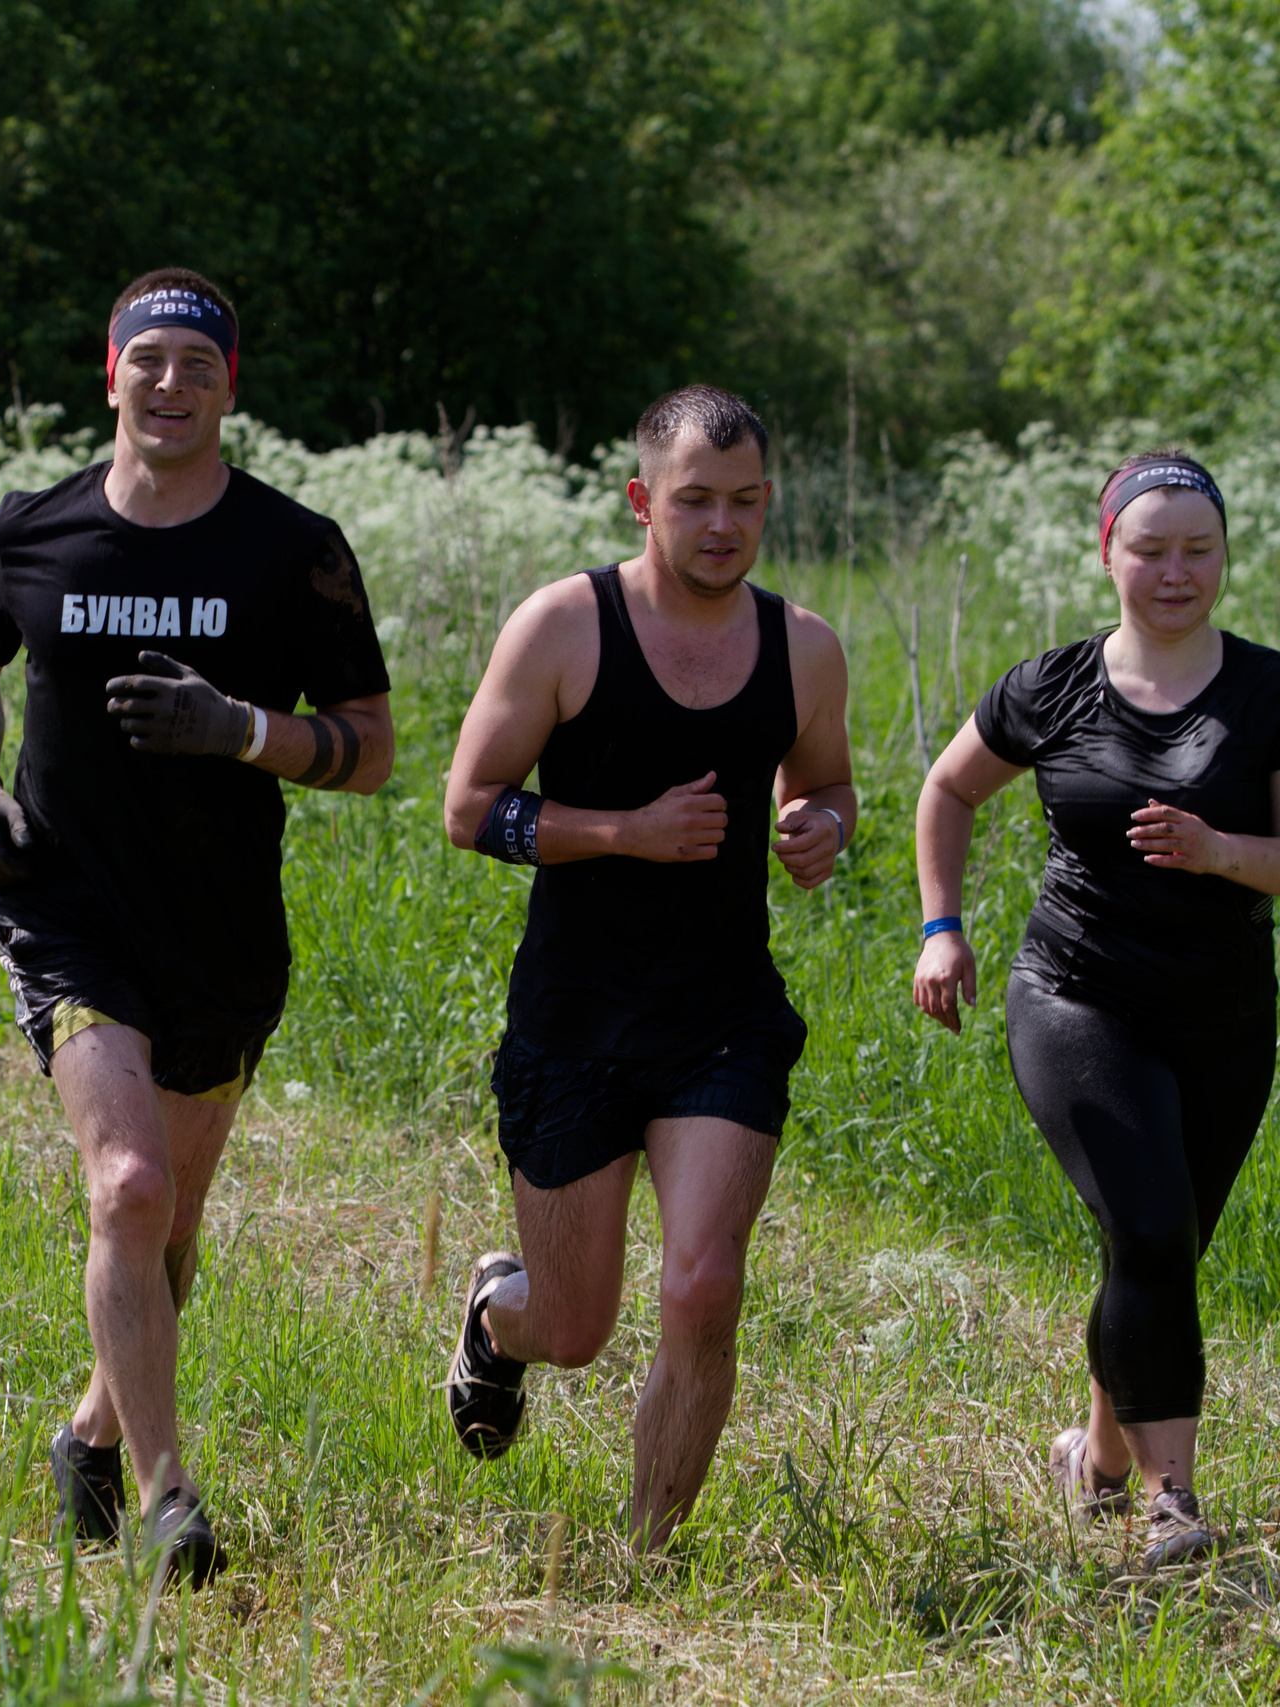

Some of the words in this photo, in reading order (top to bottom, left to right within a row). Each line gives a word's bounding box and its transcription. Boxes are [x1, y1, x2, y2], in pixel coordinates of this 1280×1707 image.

[129, 288, 198, 312] РОДЕО
[203, 298, 222, 317] 59
[150, 302, 202, 318] 2855
[1136, 466, 1207, 485] РОДЕО
[60, 593, 182, 637] БУКВА
[190, 596, 228, 638] Ю
[505, 797, 521, 820] 59
[523, 824, 542, 866] 2826
